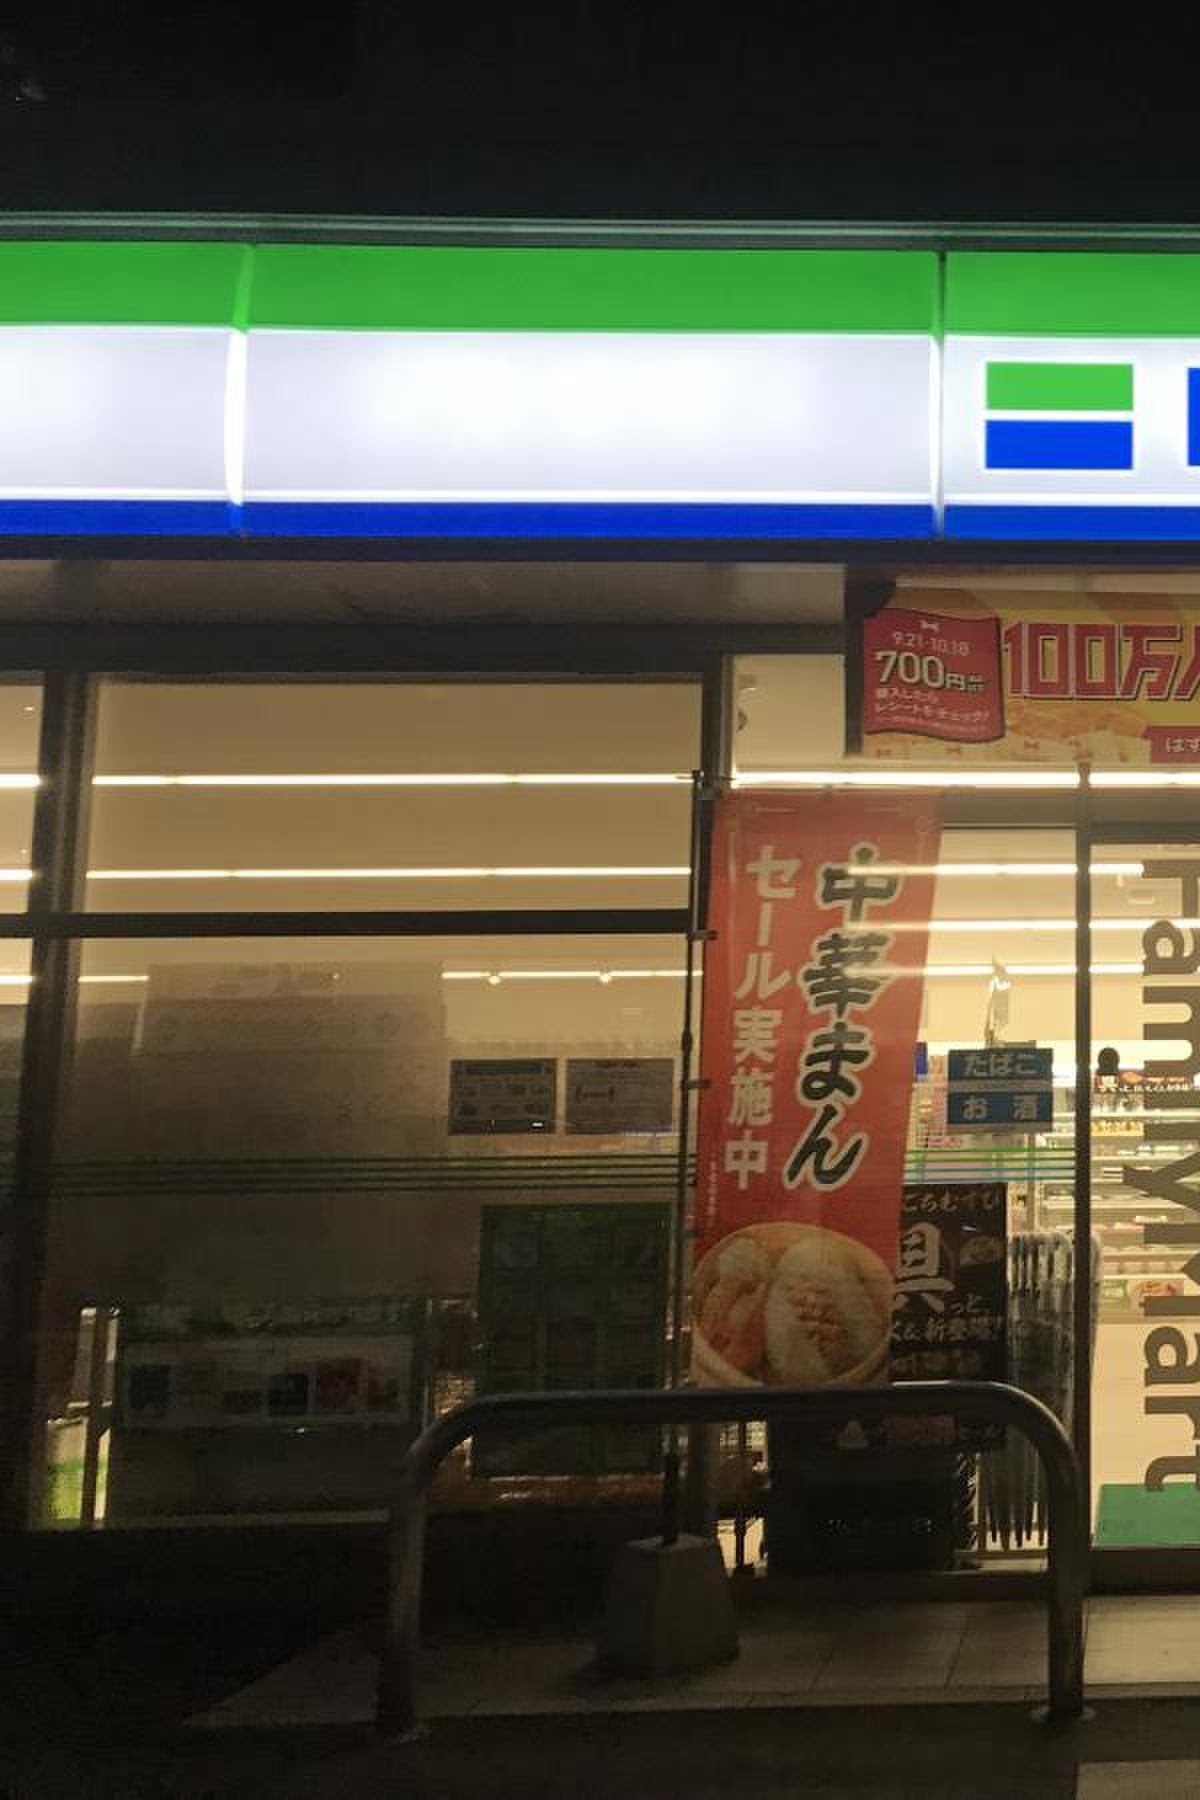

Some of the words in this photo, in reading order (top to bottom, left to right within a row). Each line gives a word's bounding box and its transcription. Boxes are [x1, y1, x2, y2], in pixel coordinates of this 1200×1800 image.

[724, 845, 802, 1190] セール実施中
[784, 844, 901, 1189] 中華まん
[962, 1054, 1039, 1078] たばこ
